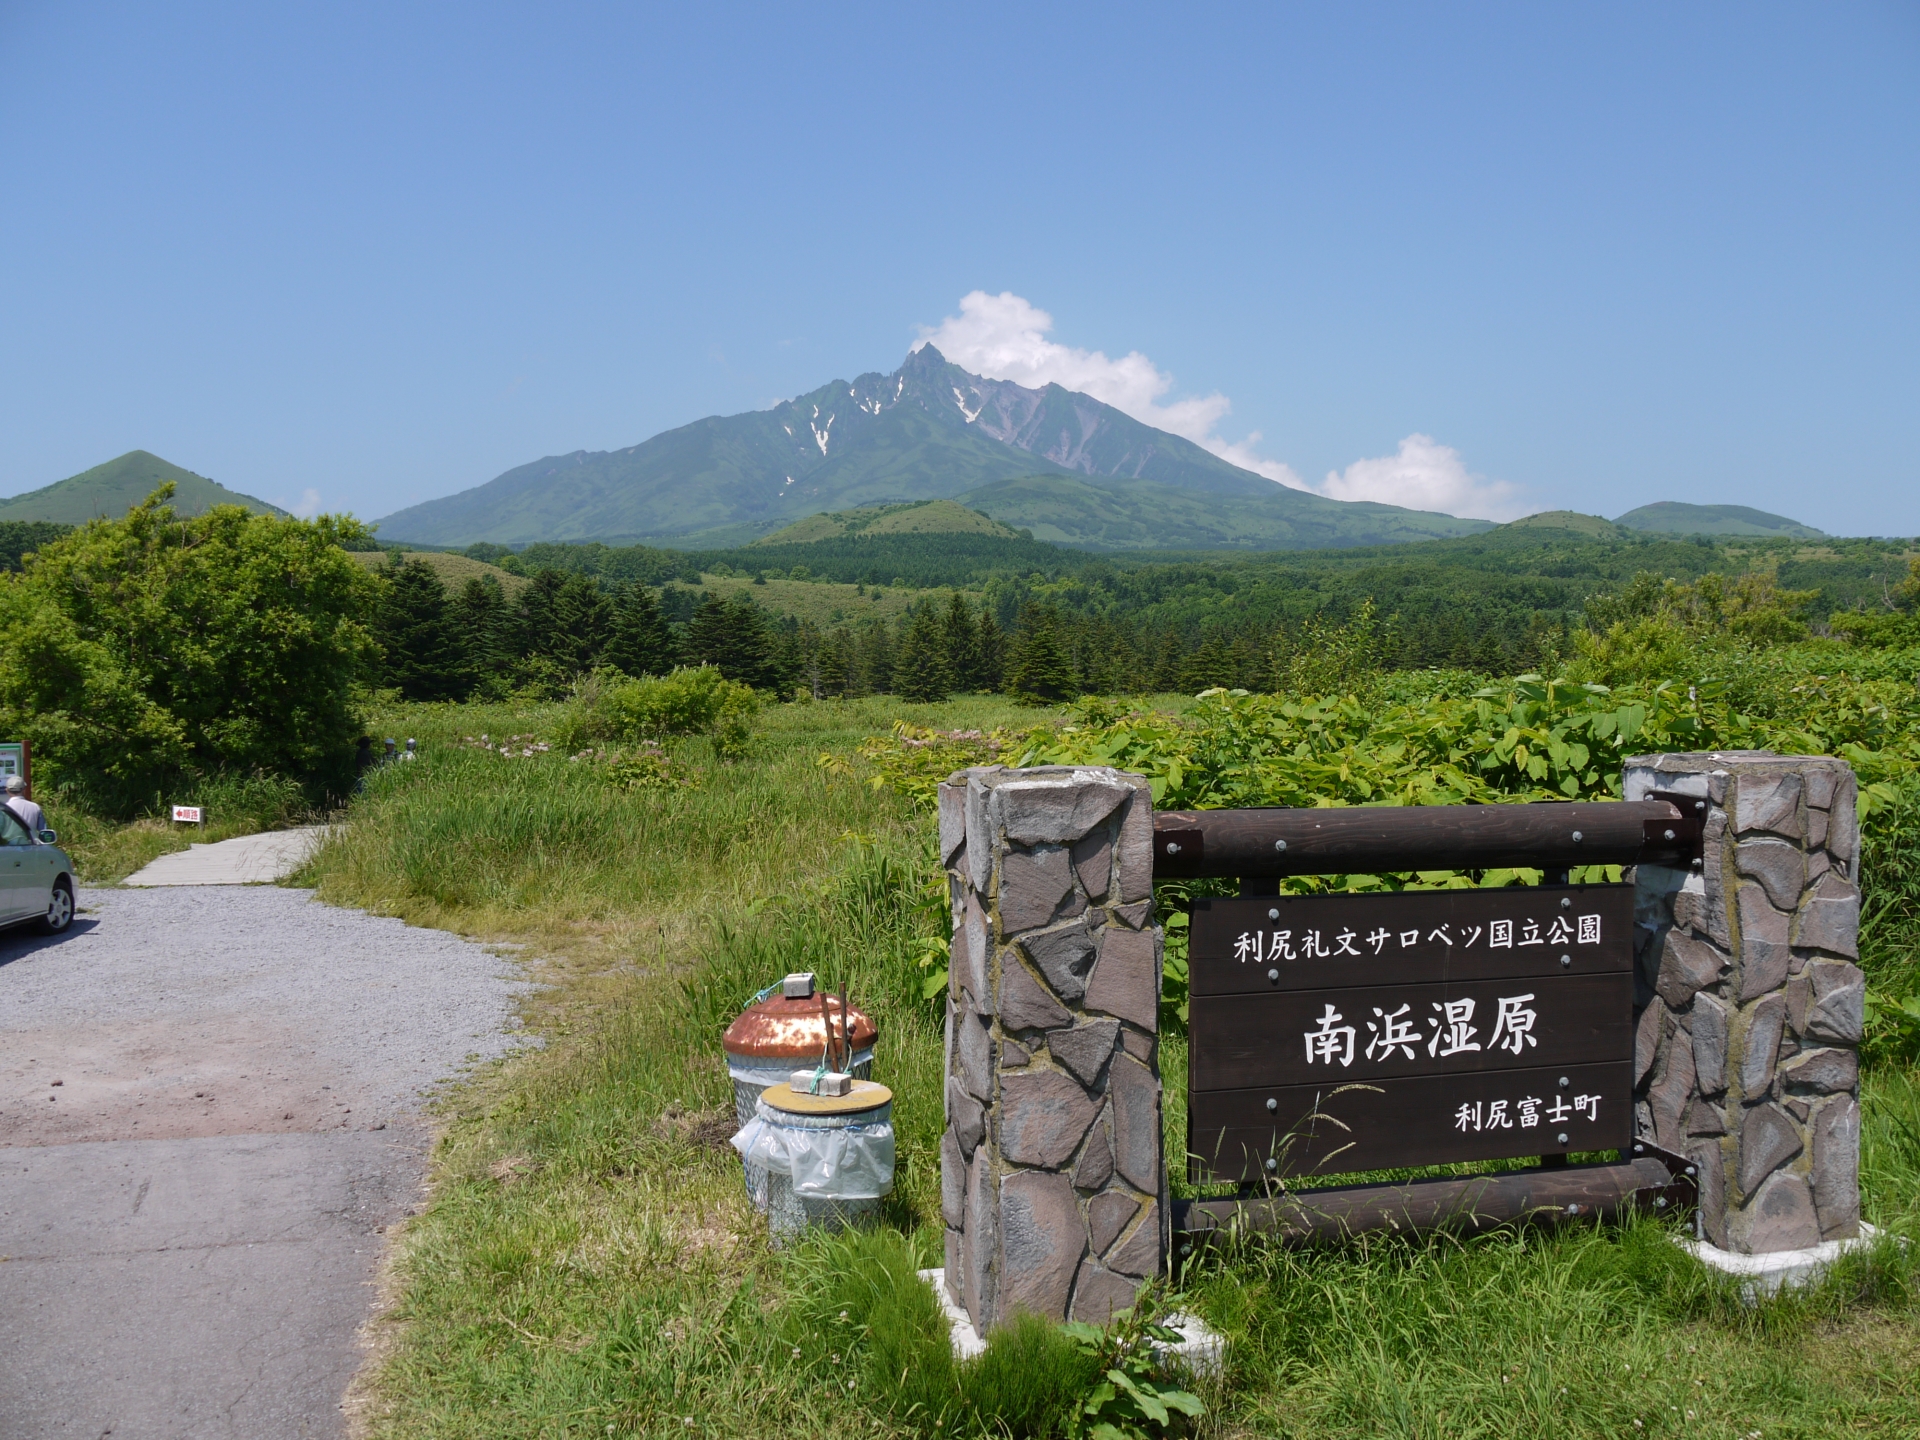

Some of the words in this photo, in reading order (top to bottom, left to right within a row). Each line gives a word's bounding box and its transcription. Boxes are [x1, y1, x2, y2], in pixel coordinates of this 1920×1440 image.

[183, 809, 198, 820] 順路
[1234, 914, 1602, 962] 利尻礼文サロベツ国立公園
[1304, 994, 1538, 1067] 南浜湿原
[1455, 1095, 1602, 1132] 利尻富士町
